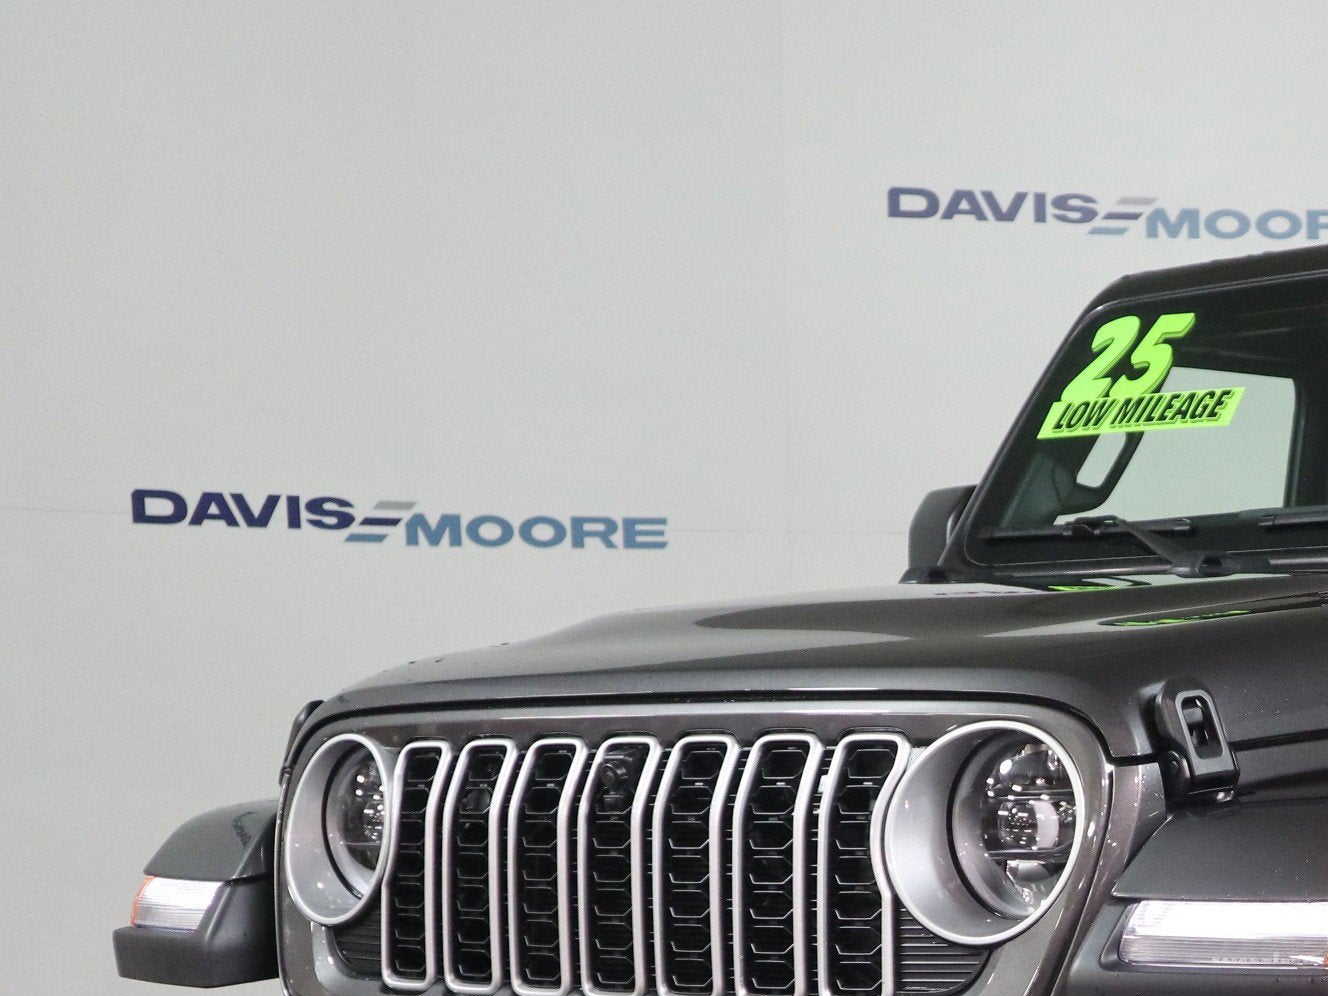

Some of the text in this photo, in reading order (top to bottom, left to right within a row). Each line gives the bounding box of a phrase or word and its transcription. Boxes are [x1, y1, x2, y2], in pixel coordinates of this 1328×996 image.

[886, 186, 1099, 225] DAVIS
[1060, 312, 1196, 402] 25
[1051, 389, 1236, 434] LOW MILEAGE
[130, 488, 669, 550] DAVIS MOORE
